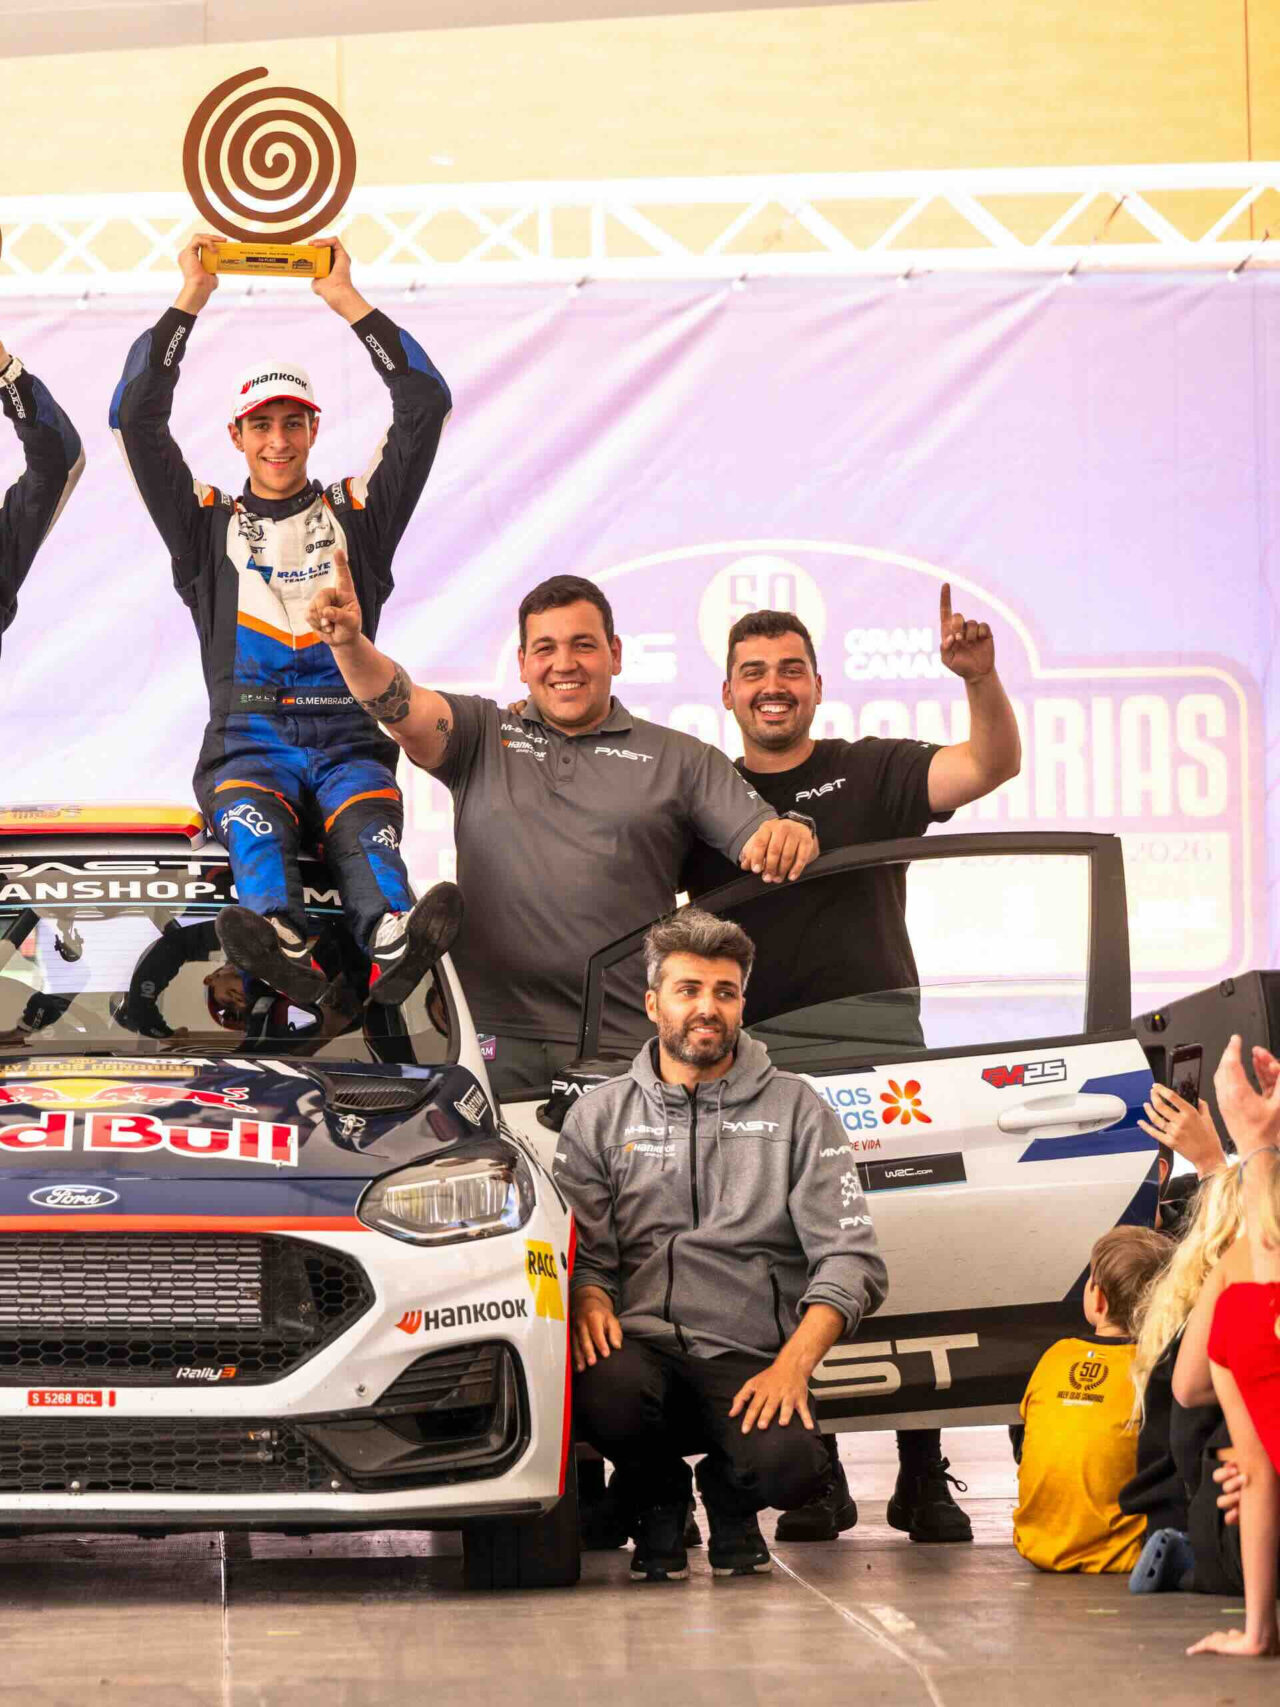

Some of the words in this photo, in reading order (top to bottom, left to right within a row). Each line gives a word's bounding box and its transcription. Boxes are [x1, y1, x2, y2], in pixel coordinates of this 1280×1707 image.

[82, 1112, 299, 1167] Bull
[45, 1186, 102, 1207] Ford
[527, 1249, 559, 1280] RACC
[1079, 1361, 1102, 1379] 50
[32, 1392, 40, 1405] S
[44, 1392, 72, 1405] 5268
[76, 1392, 97, 1405] BCL
